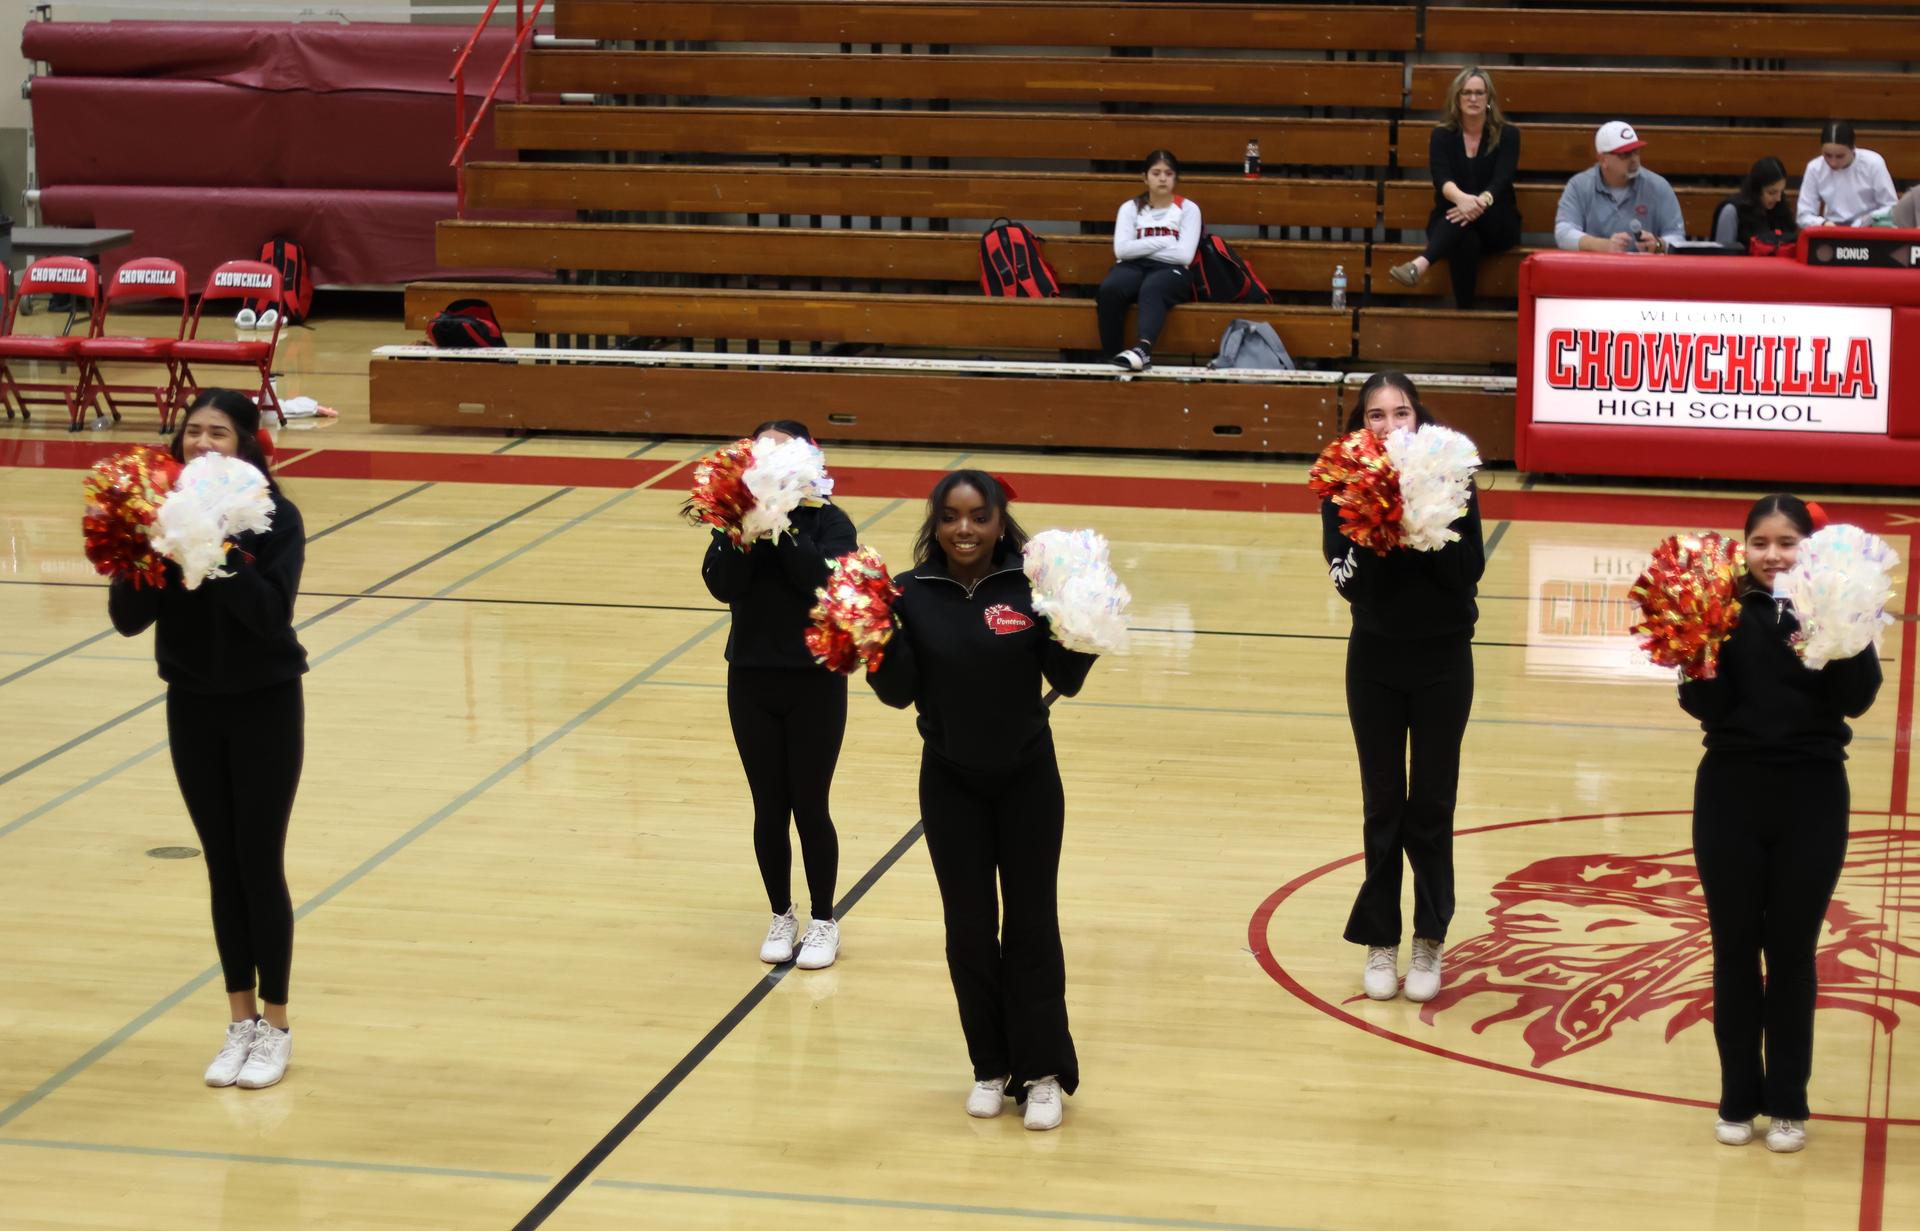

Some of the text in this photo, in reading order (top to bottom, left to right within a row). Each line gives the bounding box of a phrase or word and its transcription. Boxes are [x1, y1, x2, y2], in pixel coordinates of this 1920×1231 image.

[1620, 128, 1634, 140] C
[1836, 247, 1869, 260] BONUS
[31, 268, 87, 284] CHOWCHILLA
[119, 270, 176, 285] CHOWCHILLA
[215, 272, 273, 288] CHOWCHILLA
[1641, 310, 1786, 326] WELCOME TO
[1546, 328, 1877, 399] CHOWCHILLA
[1598, 399, 1822, 422] HIGH SCHOOL
